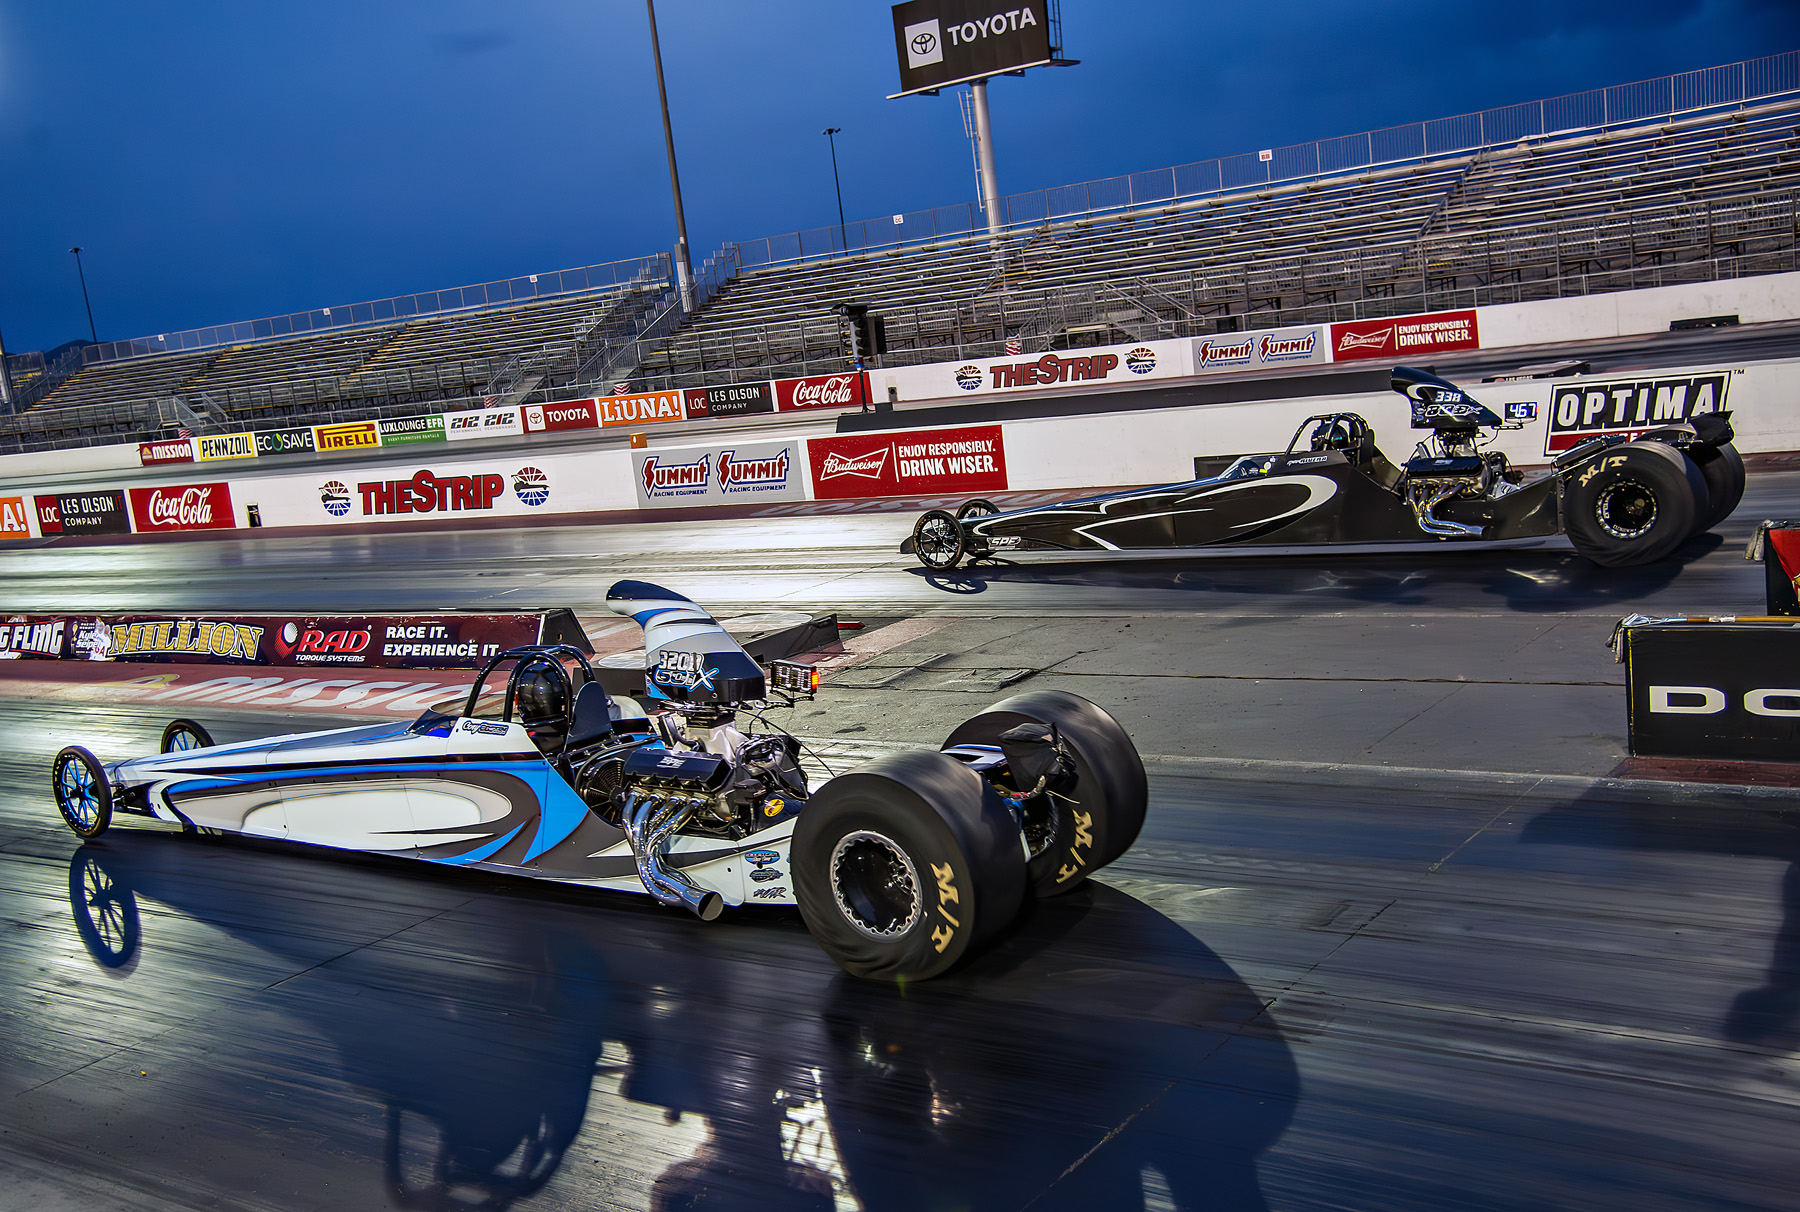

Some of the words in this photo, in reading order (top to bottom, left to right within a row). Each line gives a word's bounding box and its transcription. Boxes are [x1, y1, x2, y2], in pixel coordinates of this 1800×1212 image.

[947, 7, 1037, 46] TOYOTA
[1398, 326, 1420, 335] ENJOY
[1421, 319, 1472, 333] RESPONSIBLY.
[1341, 335, 1387, 347] Budweiser
[1400, 332, 1434, 347] DRINK
[1434, 329, 1472, 344] WISER.
[709, 389, 727, 403] LES
[729, 387, 760, 401] OLSON
[792, 376, 854, 407] Coca-Cola
[601, 395, 681, 422] LiUNA!
[689, 397, 707, 410] LOC
[711, 402, 748, 412] COMPANY
[1556, 382, 1716, 427] OPTIMA
[450, 415, 481, 430] 212
[484, 412, 515, 427] 212
[546, 407, 591, 423] TOYOTA
[379, 418, 426, 434] LUXLOUNGE
[427, 417, 445, 429] EFR
[256, 431, 314, 452] ECOSAVE
[316, 424, 378, 449] PIRELLI
[152, 443, 192, 460] MISSION
[201, 435, 252, 458] PENNZOIL
[898, 444, 927, 458] ENJOY
[928, 440, 997, 456] RESPONSIBLY.
[823, 457, 883, 475] Budweiser
[899, 458, 946, 478] DRINK
[946, 455, 999, 475] WISER.
[1578, 455, 1628, 488] M/T
[653, 490, 675, 498] RACING
[675, 488, 708, 497] EQUIPMENT
[752, 484, 787, 492] EQUIPMENT
[61, 498, 79, 515] LES
[81, 496, 114, 513] OLSON
[114, 495, 123, 512] IT
[148, 487, 213, 526] Coca-Cola
[0, 502, 27, 533] A!
[40, 507, 60, 523] LOC
[65, 516, 103, 528] COMPANY
[11, 621, 65, 655] FLING
[106, 620, 264, 660] MILLION
[297, 630, 371, 653] RAD
[385, 626, 426, 639] RACE
[428, 626, 449, 639] IT.
[295, 654, 327, 662] TORQUE
[326, 655, 366, 663] SYSTEMS
[382, 643, 479, 658] EXPERIENCE
[1055, 808, 1093, 884] M/T
[929, 862, 960, 954] M/T
